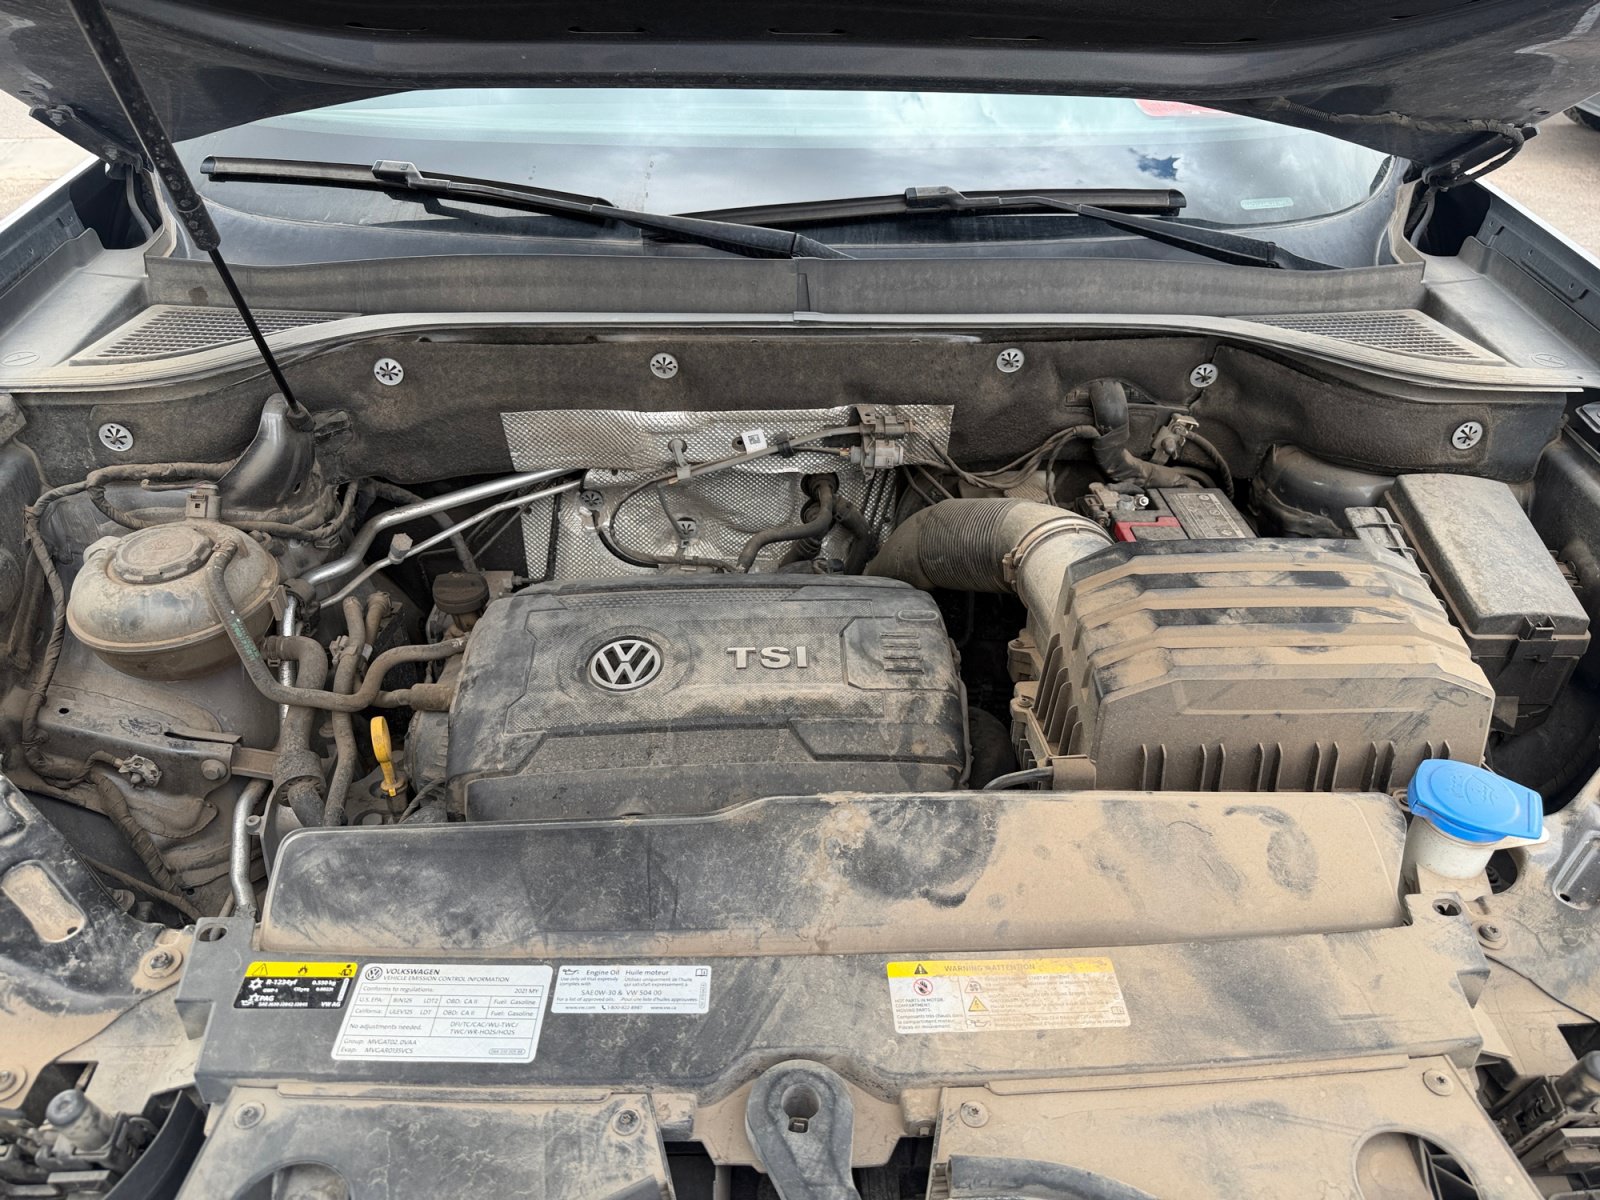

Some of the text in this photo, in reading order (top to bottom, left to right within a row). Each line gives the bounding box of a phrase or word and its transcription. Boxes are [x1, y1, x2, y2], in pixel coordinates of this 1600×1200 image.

[726, 646, 808, 670] TSI
[990, 963, 1036, 971] ATTENTION
[386, 968, 440, 976] VOLKSWAGEN
[265, 979, 298, 987] R-1234yf
